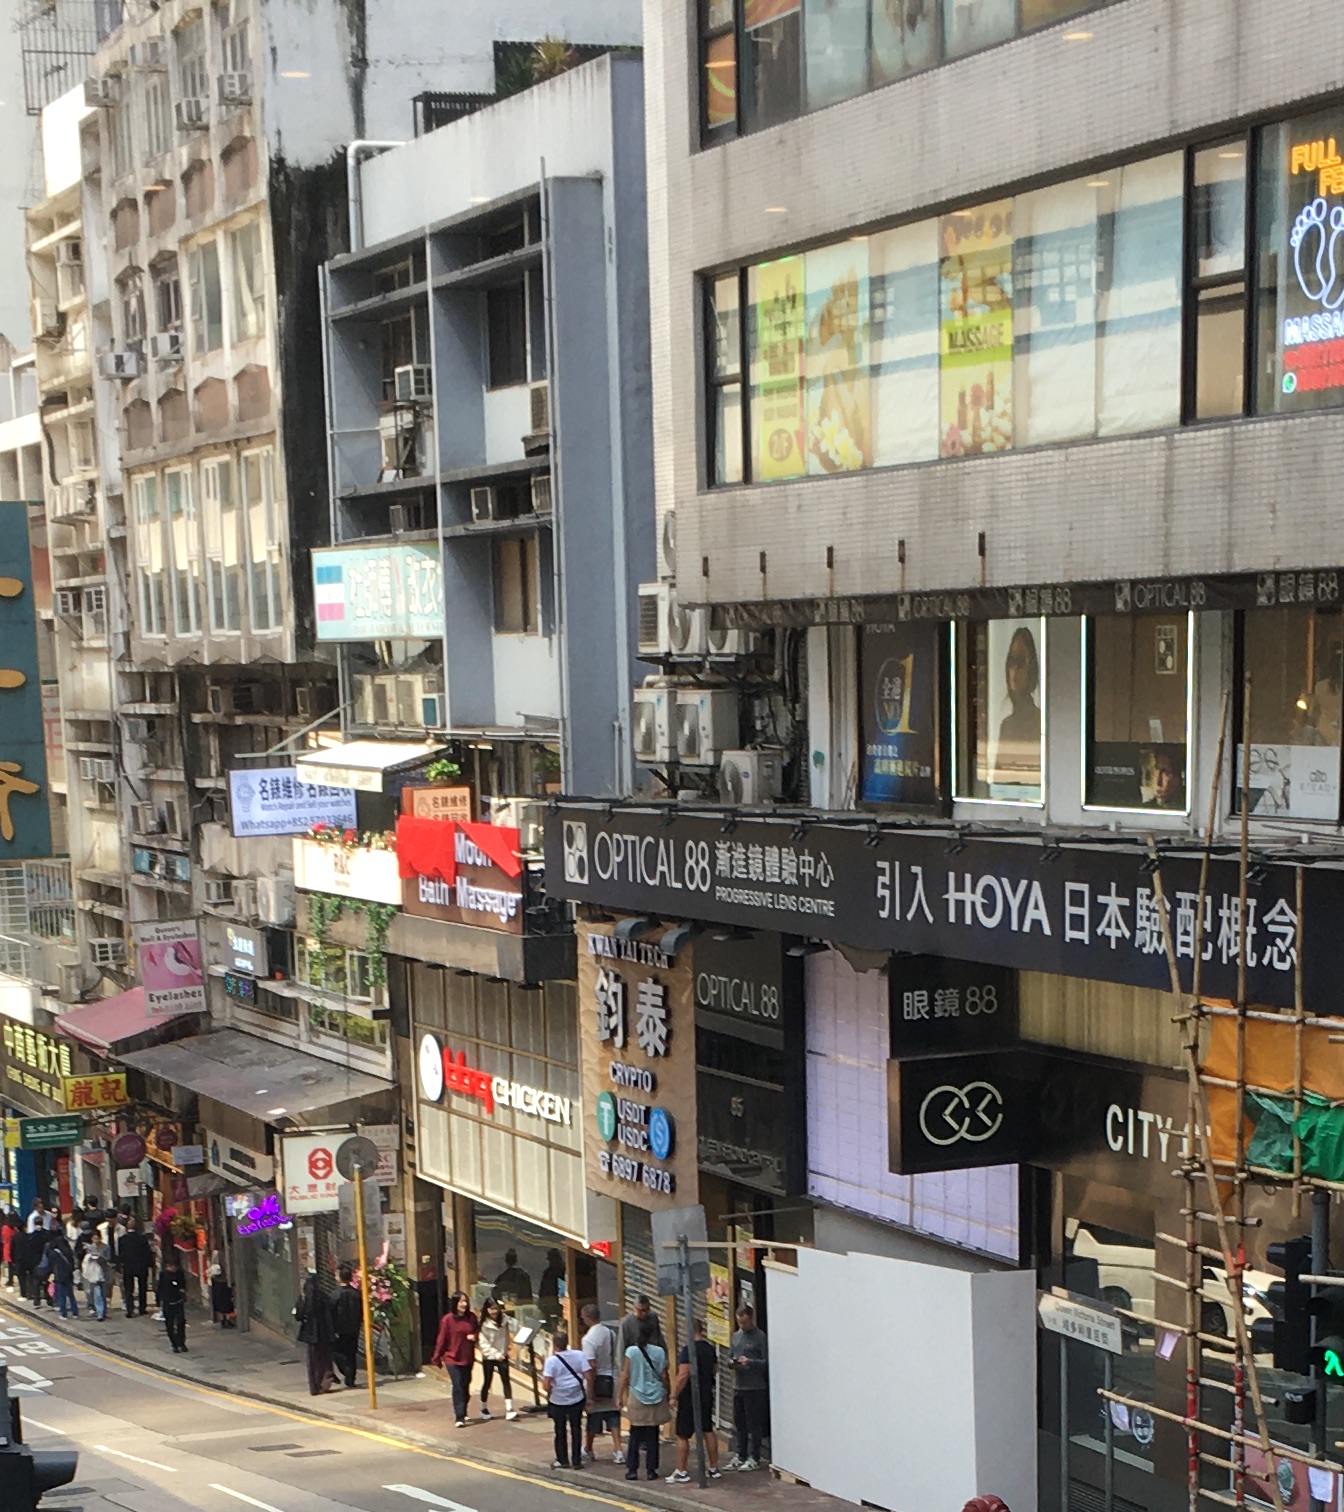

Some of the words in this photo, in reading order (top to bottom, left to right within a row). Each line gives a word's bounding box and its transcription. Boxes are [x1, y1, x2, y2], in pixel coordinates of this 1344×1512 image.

[1291, 138, 1342, 175] FULL
[1134, 584, 1189, 608] OPTICAL
[1189, 581, 1206, 606] 88
[1316, 572, 1340, 601] 88
[594, 830, 682, 890] OPTICAL
[684, 840, 711, 893] 88
[714, 839, 835, 889] 漸進鏡體驗中心
[418, 873, 450, 907] Bath
[455, 875, 517, 924] Massage
[715, 885, 773, 910] PROGRESSIVE
[774, 892, 797, 912] LENS
[797, 895, 836, 918] CENTRE
[875, 860, 934, 925] 引入
[941, 872, 1052, 938] HOYA
[1063, 881, 1300, 972] 日本驗配概念
[587, 932, 617, 959] KWAN
[618, 937, 638, 963] TAI
[638, 942, 670, 970] TECH
[147, 989, 203, 1003] Eyelashes
[594, 965, 668, 1058] 鈞泰
[696, 972, 759, 1015] OPTICAL
[760, 984, 779, 1020] 88
[902, 989, 961, 1022] 眼鏡
[965, 984, 999, 1018] 88
[70, 1077, 129, 1109] 龍記
[609, 1060, 652, 1093] CRYPTO
[491, 1076, 571, 1125] CHICKEN
[617, 1096, 646, 1126] USDT
[617, 1122, 648, 1152] USDC
[1105, 1103, 1173, 1163] CITY
[611, 1153, 639, 1183] 6897
[642, 1164, 671, 1195] 6878
